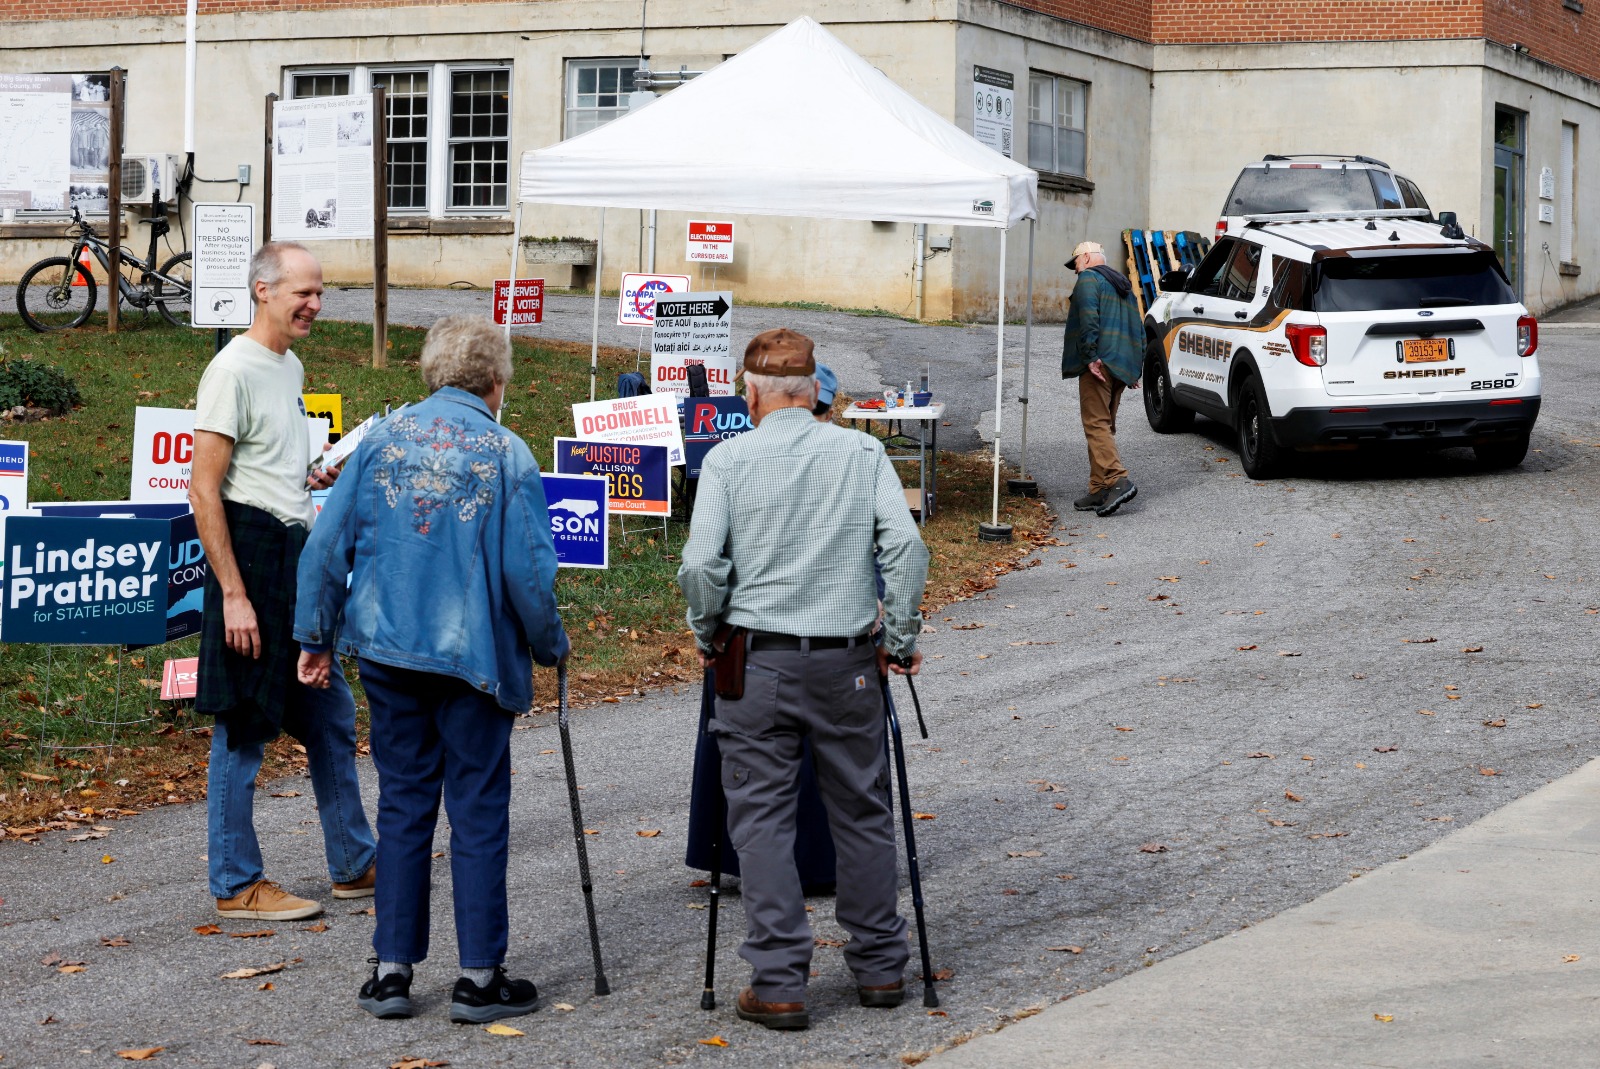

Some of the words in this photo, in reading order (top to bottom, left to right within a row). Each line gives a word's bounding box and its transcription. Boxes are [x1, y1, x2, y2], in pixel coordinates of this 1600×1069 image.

[706, 224, 716, 232] NO
[646, 280, 668, 291] NO
[626, 290, 656, 298] CAMPA
[498, 300, 514, 310] FO
[516, 299, 540, 310] VOTER
[662, 304, 686, 316] VOTE
[688, 302, 714, 314] HERE
[502, 312, 536, 324] PRKING
[656, 319, 674, 328] VOTE
[674, 316, 691, 328] AQUÍ
[676, 342, 690, 352] aici
[1178, 330, 1232, 363] SHERIFF
[1409, 345, 1443, 357] 39153-W
[684, 358, 705, 366] BRUCE
[658, 366, 730, 385] OCOELL
[1178, 368, 1205, 380] BUNCOMBE
[1205, 371, 1226, 384] COUNTY
[1383, 368, 1466, 380] SHERIFF
[656, 386, 684, 394] COUNTY
[1470, 378, 1515, 390] 2580
[612, 400, 638, 412] BRUCE
[582, 406, 673, 435] OCONNELL
[620, 430, 673, 442] COMMISSION
[570, 443, 588, 457] Keep!
[586, 446, 641, 465] JUSTICE
[592, 464, 635, 472] ALLISON
[583, 472, 643, 498] GGS
[625, 501, 646, 510] Court
[560, 534, 599, 542] GENERAL
[12, 538, 162, 576] Lindsey
[10, 570, 158, 610] Prather
[34, 610, 54, 622] for
[56, 604, 101, 620] STATE
[104, 600, 154, 616] HOUSE
